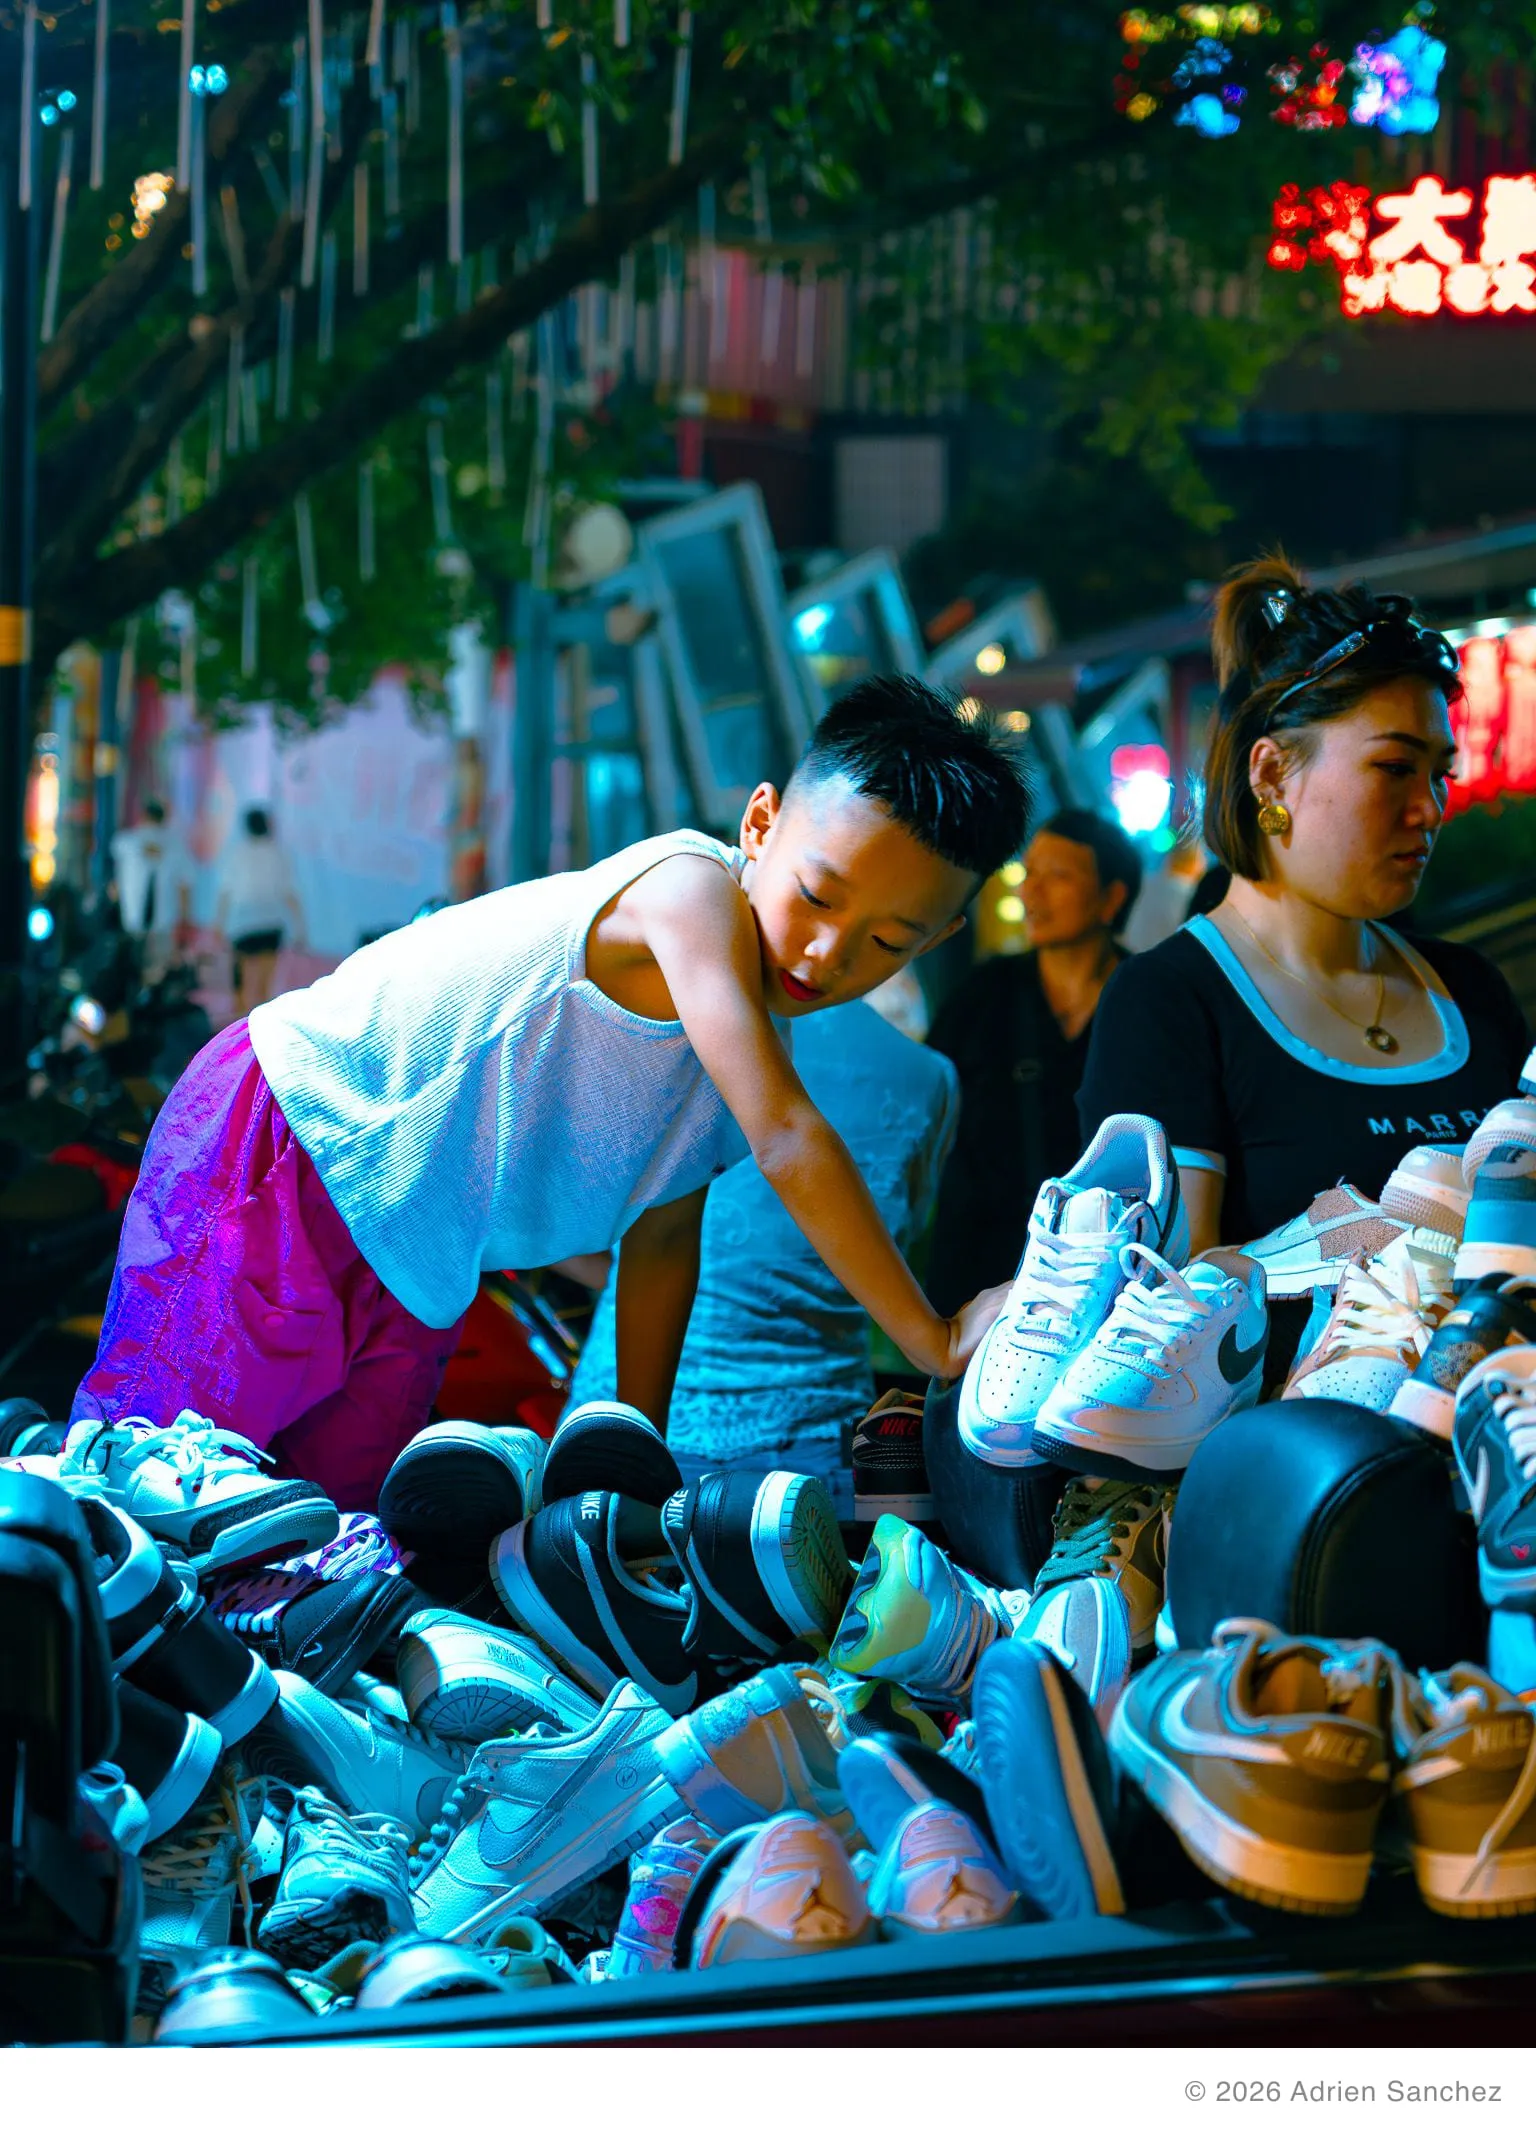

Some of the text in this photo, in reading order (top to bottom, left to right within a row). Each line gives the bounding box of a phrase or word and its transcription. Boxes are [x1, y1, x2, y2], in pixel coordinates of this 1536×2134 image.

[1367, 1109, 1488, 1135] MARR
[666, 1489, 689, 1529] NIKE
[1303, 1720, 1369, 1767] NIKE
[1471, 1715, 1531, 1756] NIKE
